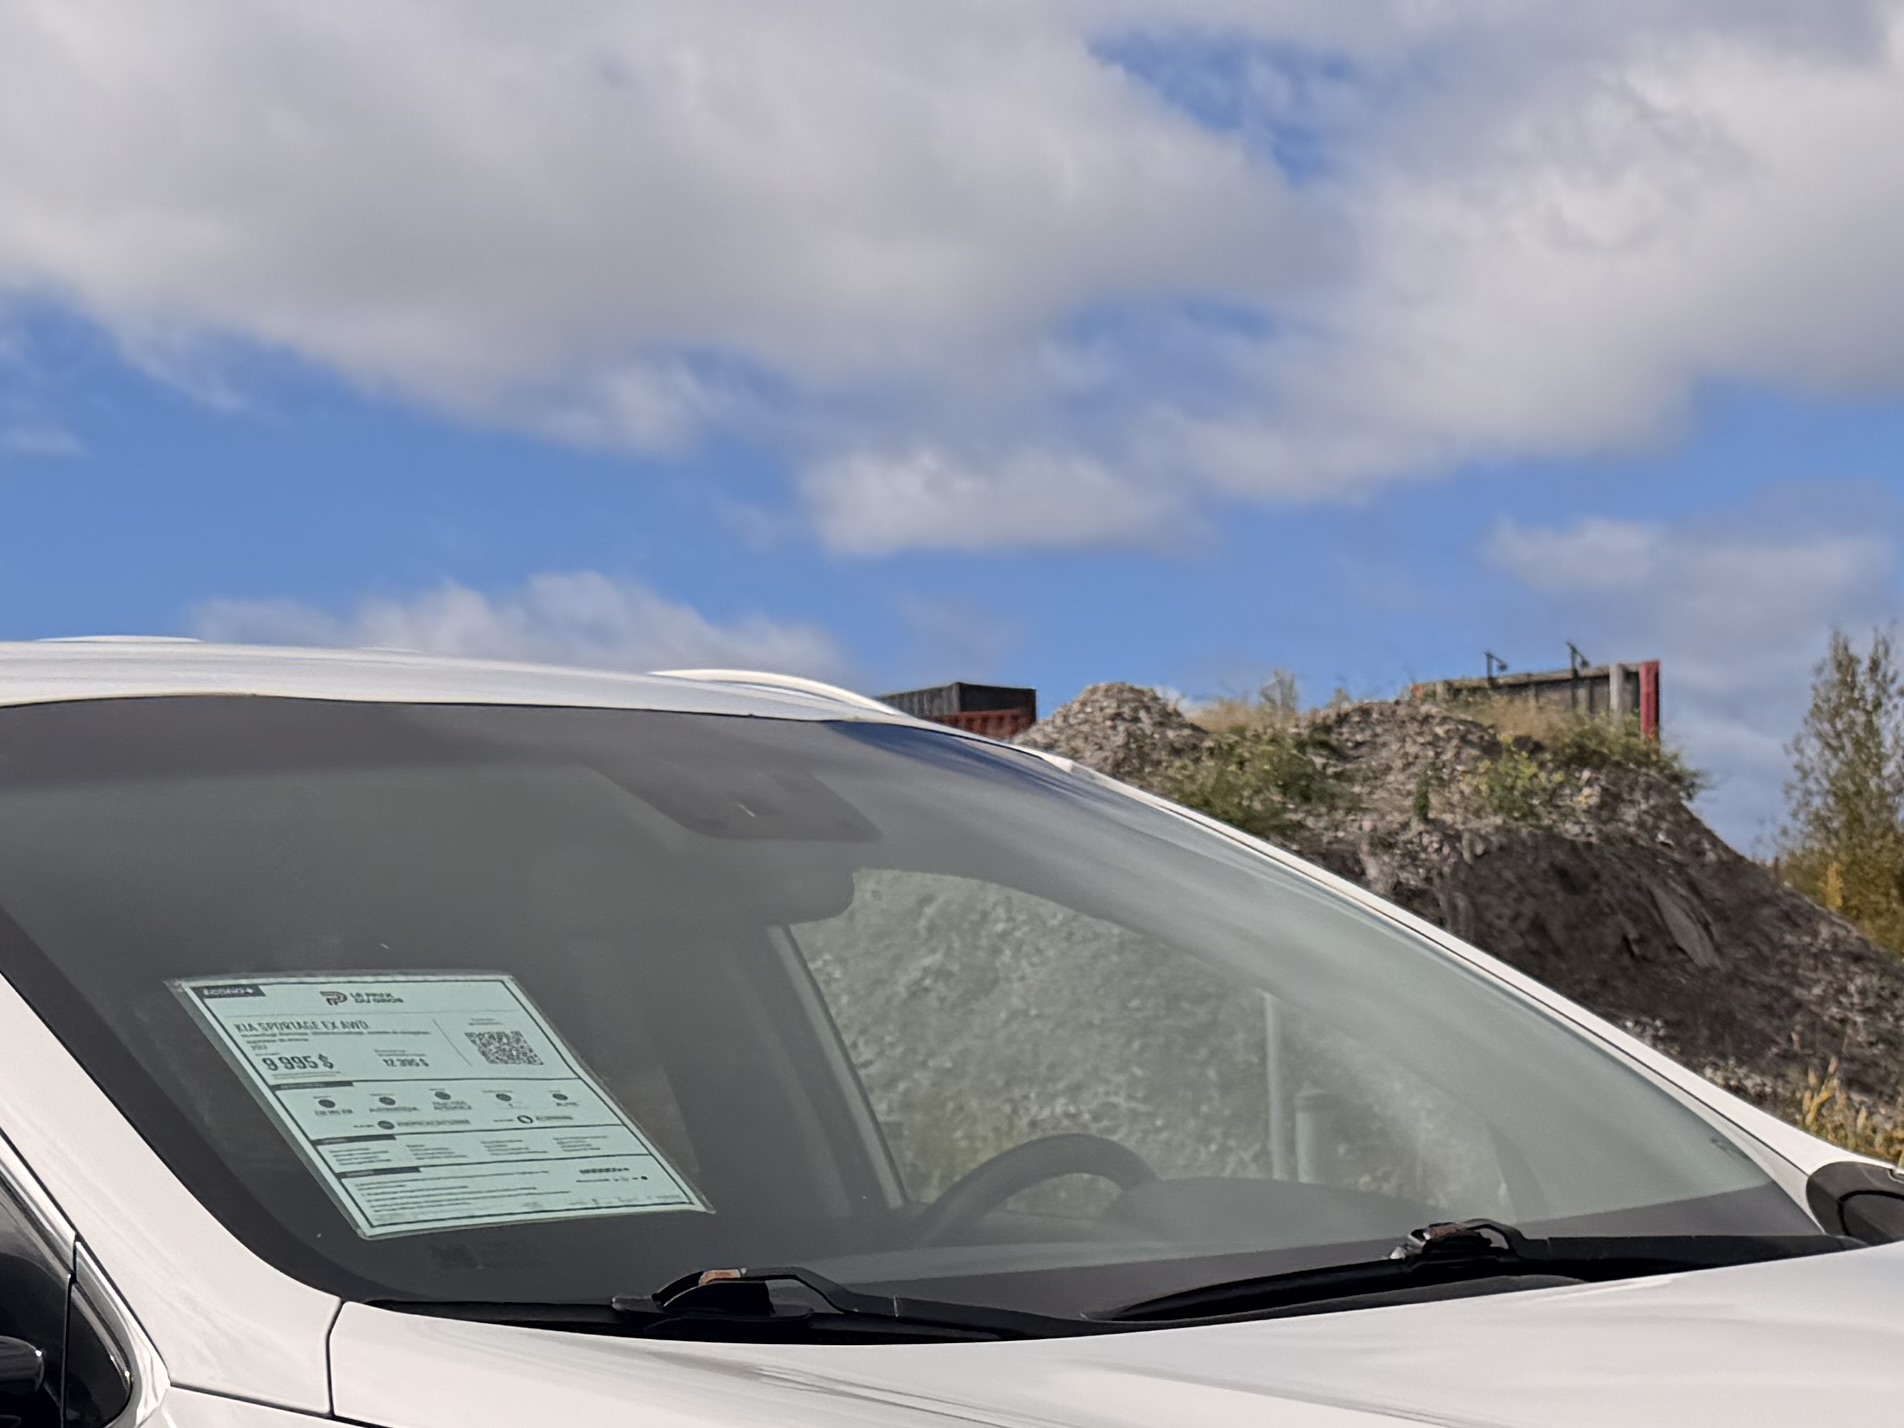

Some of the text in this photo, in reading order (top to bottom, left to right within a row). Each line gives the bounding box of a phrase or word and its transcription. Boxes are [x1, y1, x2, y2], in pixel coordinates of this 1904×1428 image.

[234, 1023, 257, 1033] KIA
[258, 1021, 321, 1032] SPORTAGE
[340, 1020, 370, 1030] AWD
[278, 1056, 318, 1070] 995
